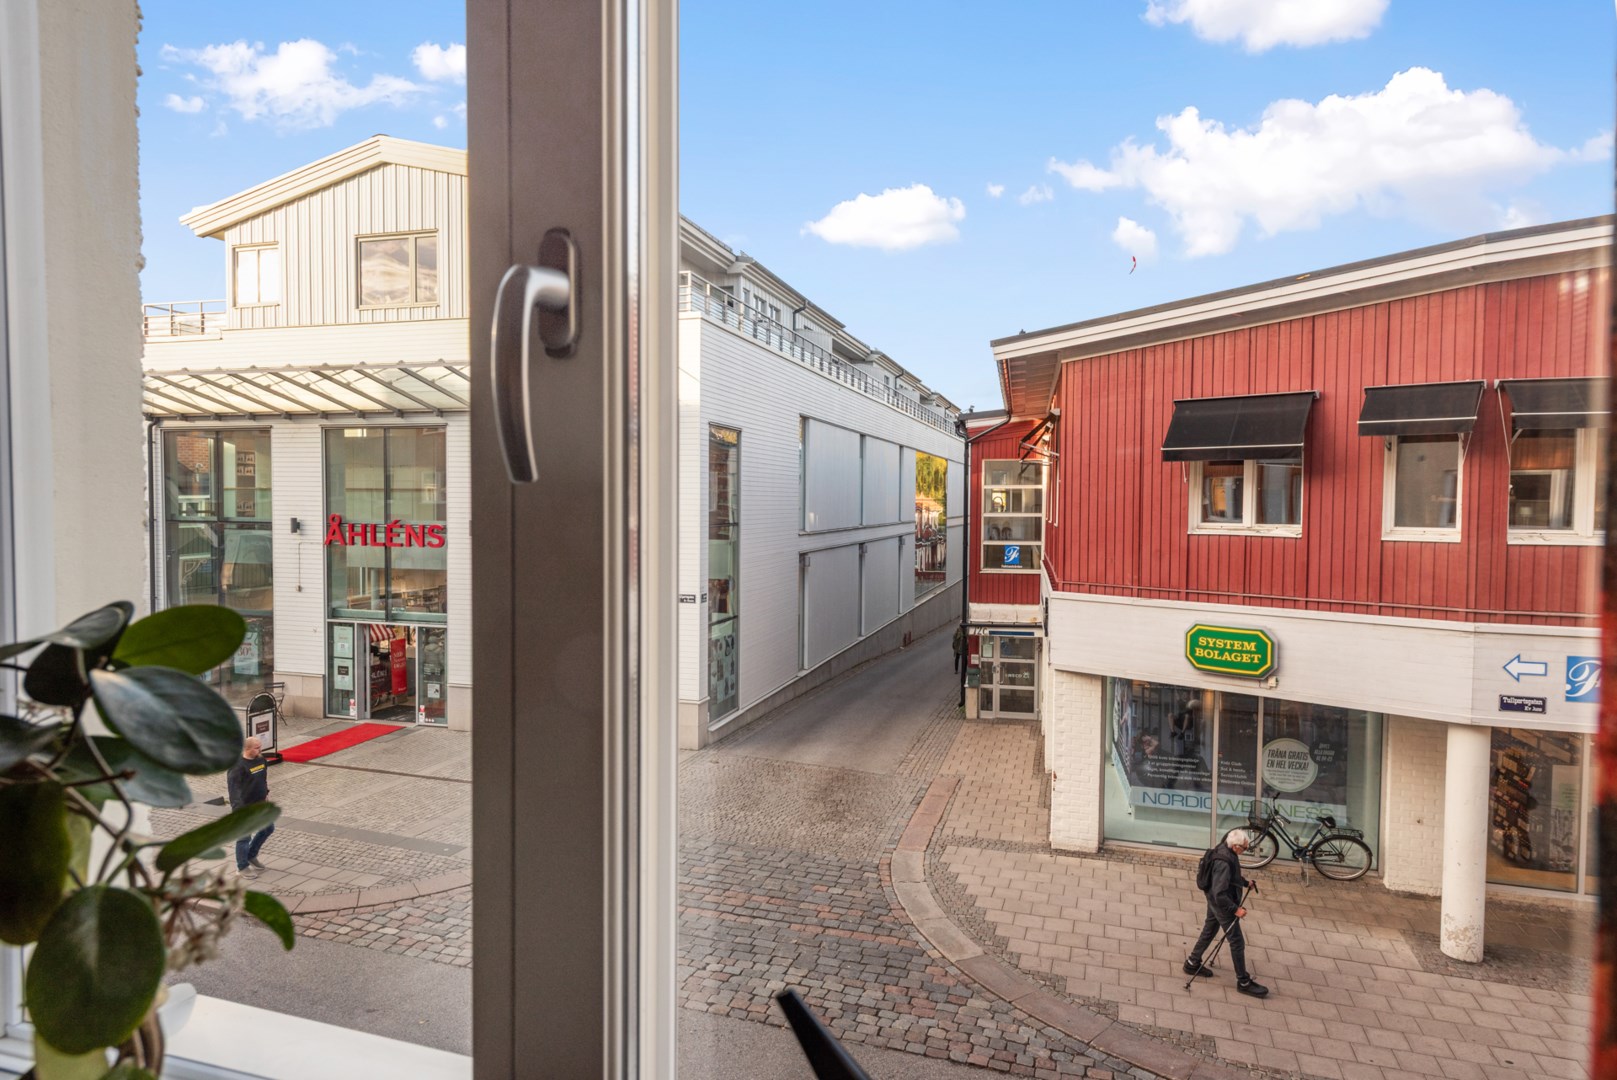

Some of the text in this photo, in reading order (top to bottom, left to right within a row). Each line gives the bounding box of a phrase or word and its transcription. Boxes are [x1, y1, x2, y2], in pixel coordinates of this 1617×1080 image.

[324, 513, 445, 549] ÅHLÉNS
[1199, 637, 1257, 651] SYSTEM
[1195, 648, 1261, 663] BOLAGET
[1268, 747, 1309, 761] TRÄNA GRATIS
[1266, 759, 1276, 768] EN
[1276, 760, 1287, 769] HEL
